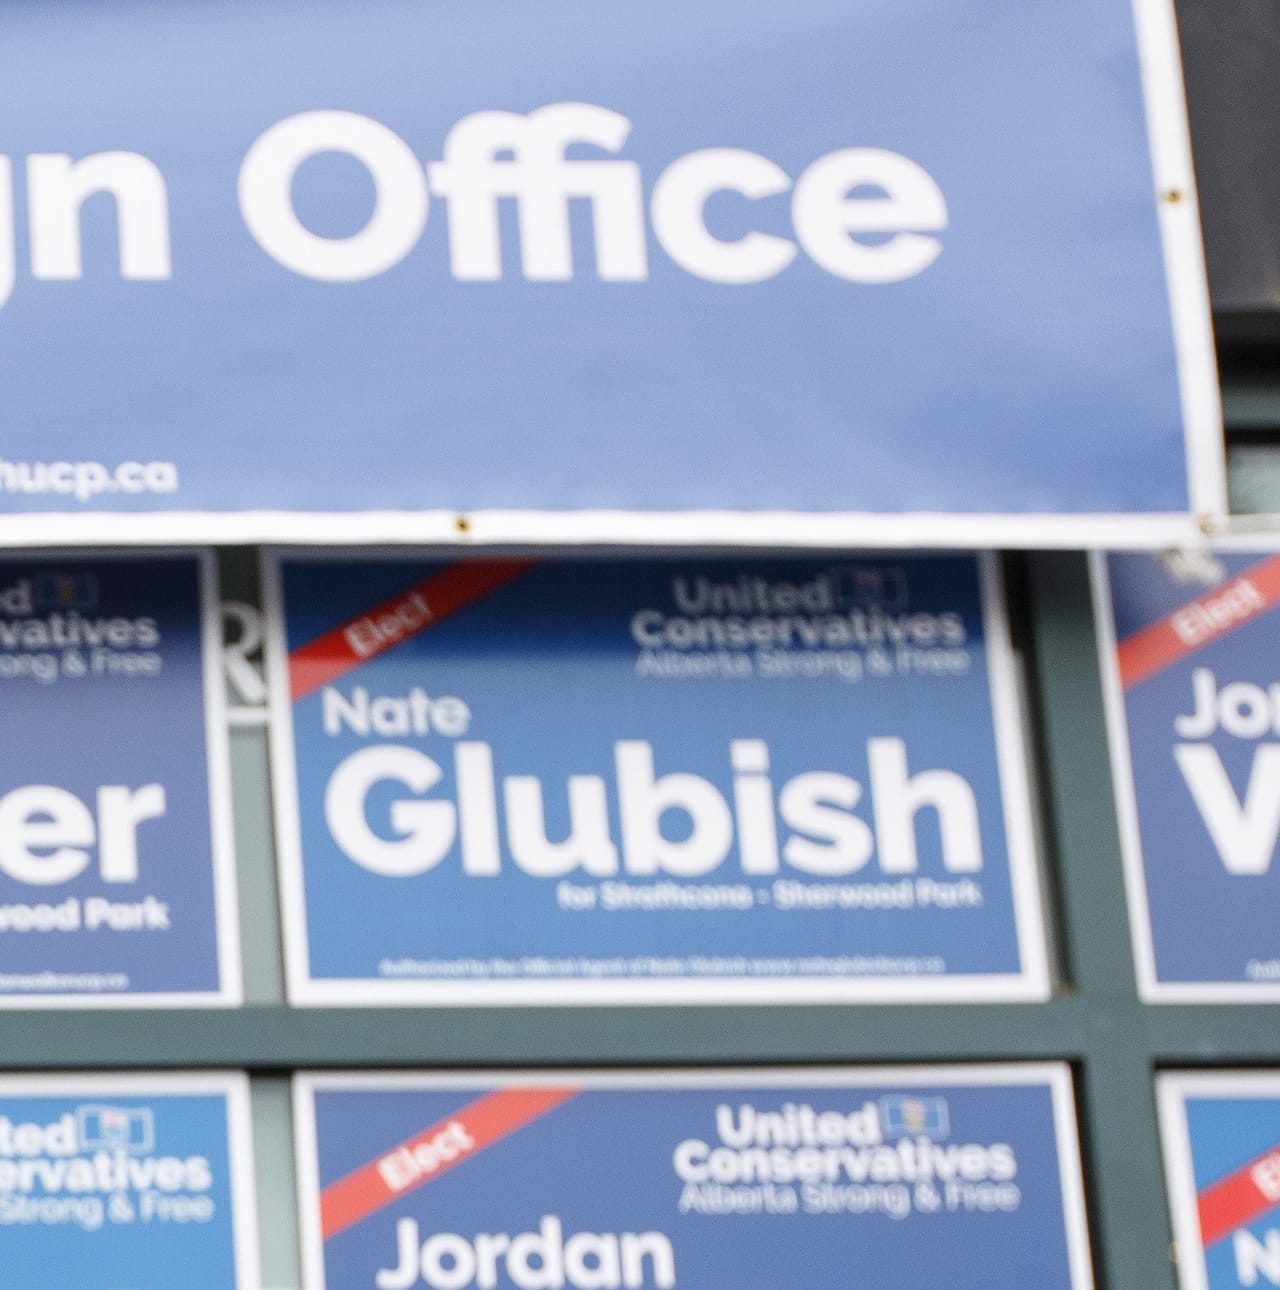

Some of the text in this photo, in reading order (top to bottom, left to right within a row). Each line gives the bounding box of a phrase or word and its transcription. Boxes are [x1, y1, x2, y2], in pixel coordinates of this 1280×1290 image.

[239, 103, 949, 284] Office
[673, 577, 835, 615] United
[1172, 578, 1269, 648] Elect
[342, 590, 436, 661] Elect
[632, 608, 966, 649] Conservatives
[62, 649, 85, 676] &
[92, 649, 158, 678] Free
[639, 649, 748, 678] Alberta
[757, 649, 863, 683] Strong
[897, 646, 967, 677] Free
[322, 685, 471, 737] Nate
[324, 737, 983, 877] Glubish
[84, 896, 170, 930] Park
[556, 881, 597, 909] for
[599, 881, 754, 910] Strathcona
[773, 879, 917, 909] Sherwood
[918, 878, 982, 907] Park
[716, 1102, 878, 1148] United
[377, 1119, 475, 1194] Elect
[674, 1140, 1016, 1182] Conservatives
[109, 1191, 135, 1222] &
[139, 1191, 214, 1221] Free
[679, 1180, 1020, 1219] Alberta Strong & Free
